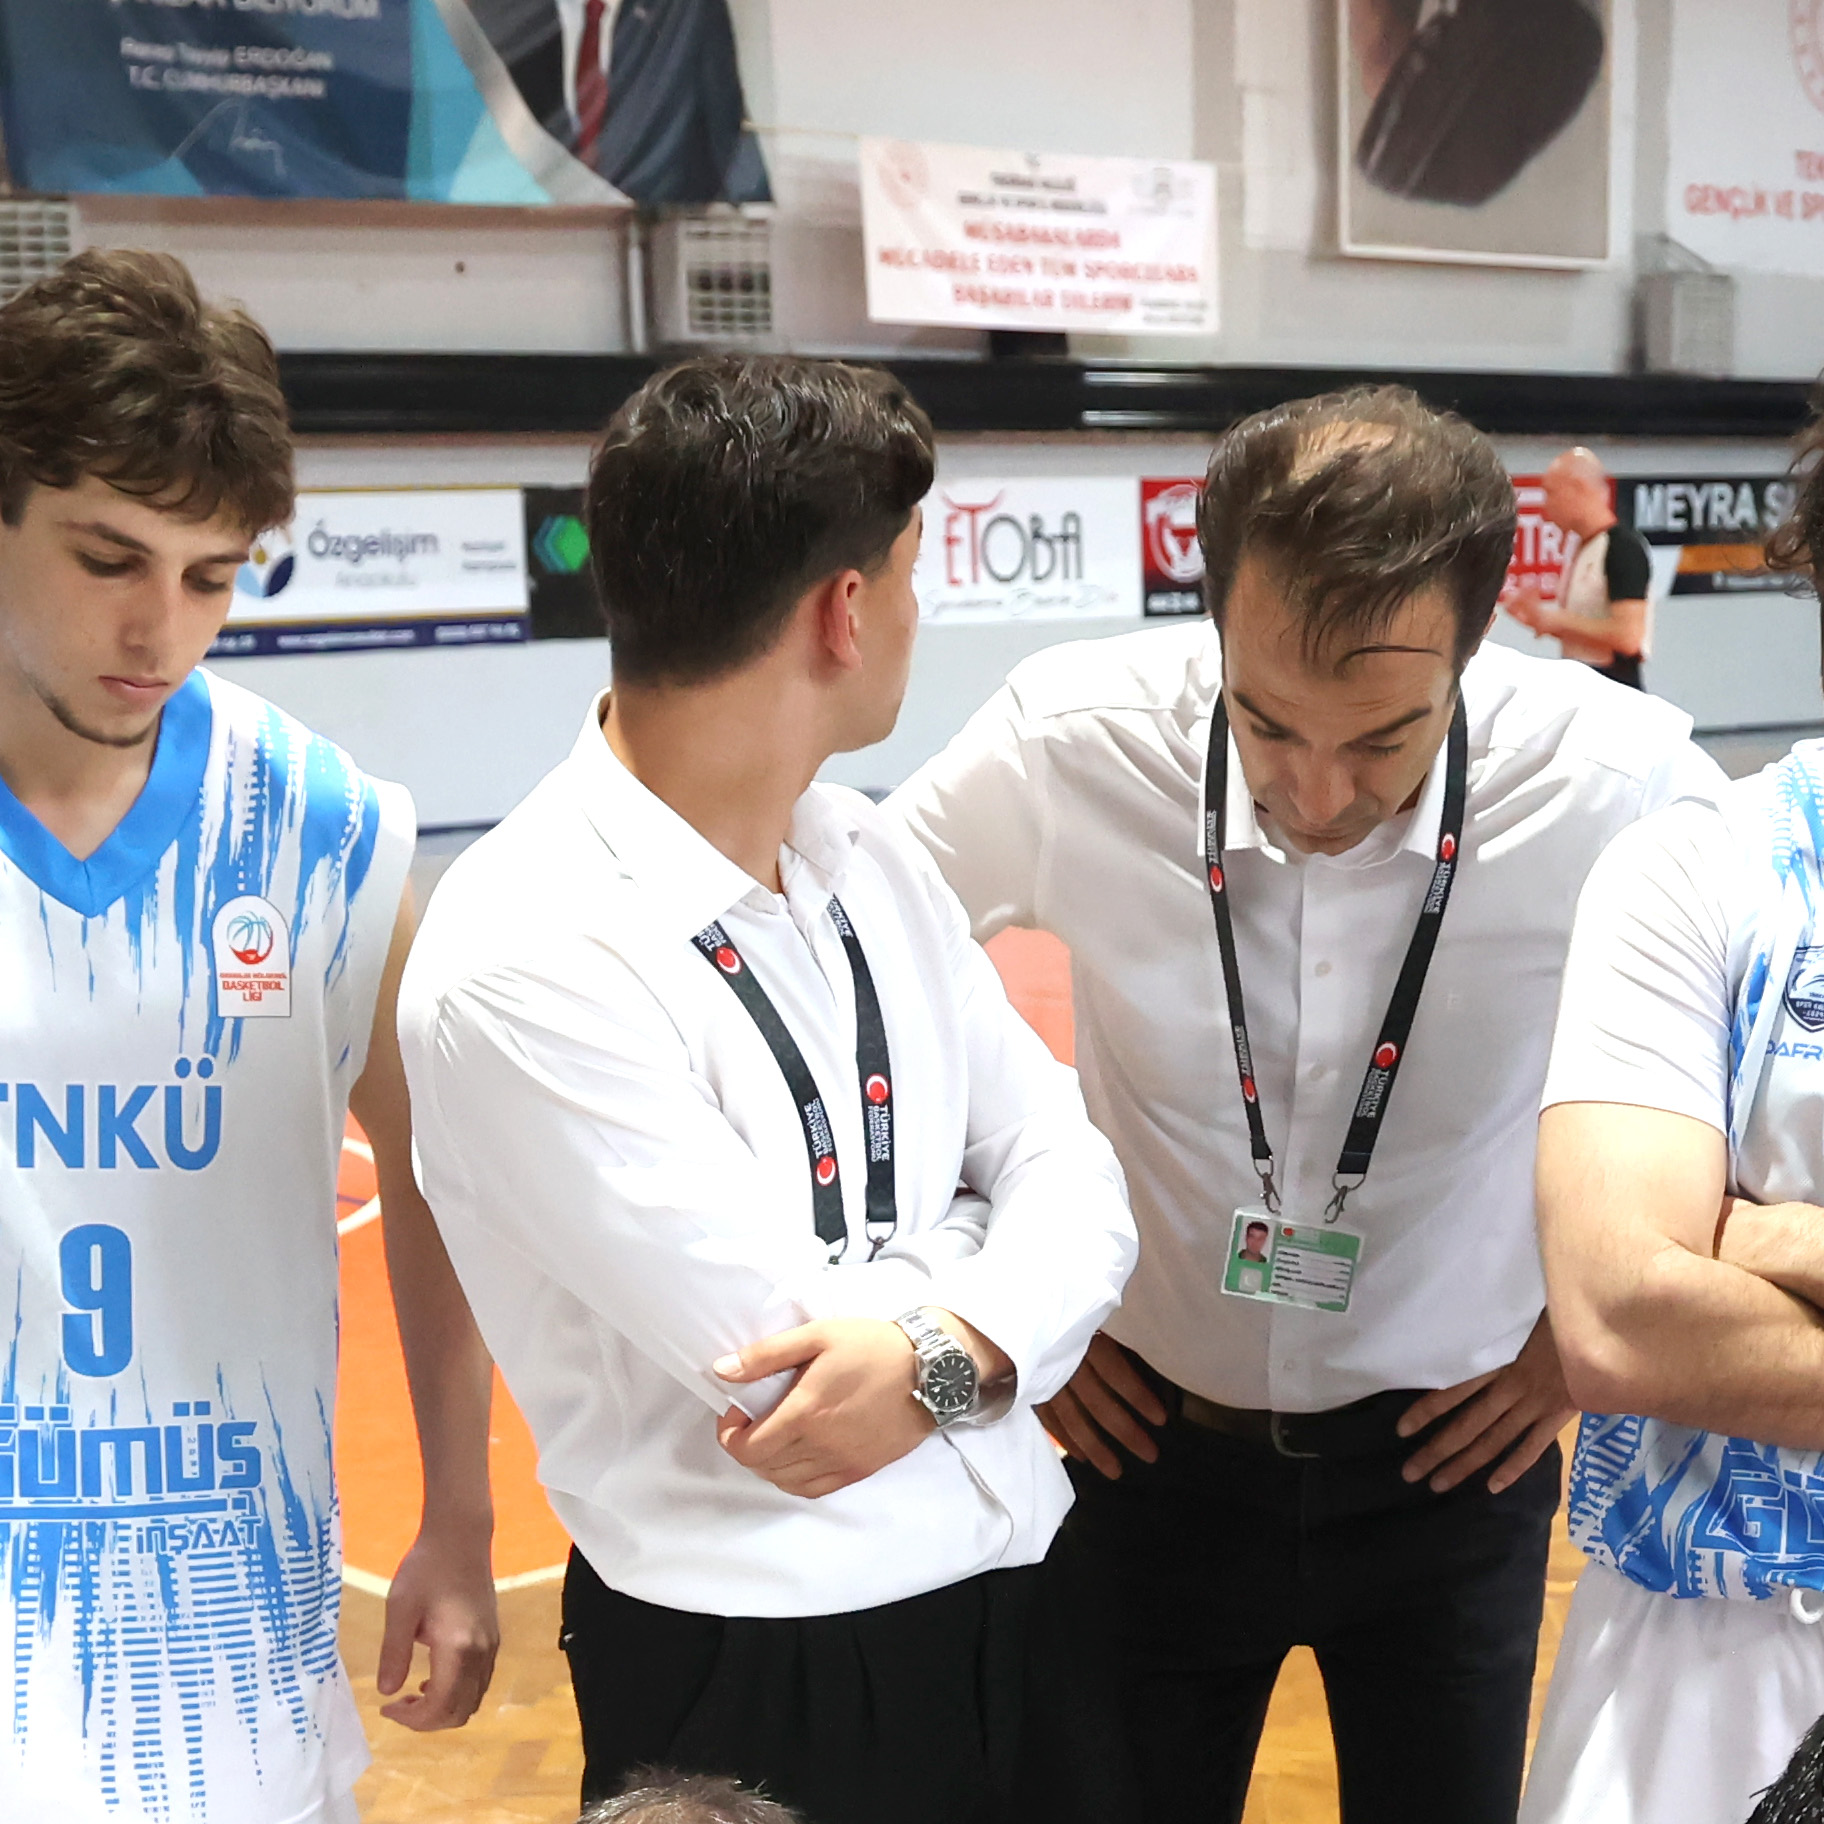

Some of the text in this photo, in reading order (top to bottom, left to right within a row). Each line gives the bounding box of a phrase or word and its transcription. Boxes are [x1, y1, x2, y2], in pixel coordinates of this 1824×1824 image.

[1634, 482, 1759, 533] MEYRA
[879, 1104, 892, 1161] TÜRKİYE
[58, 1223, 133, 1378] 9
